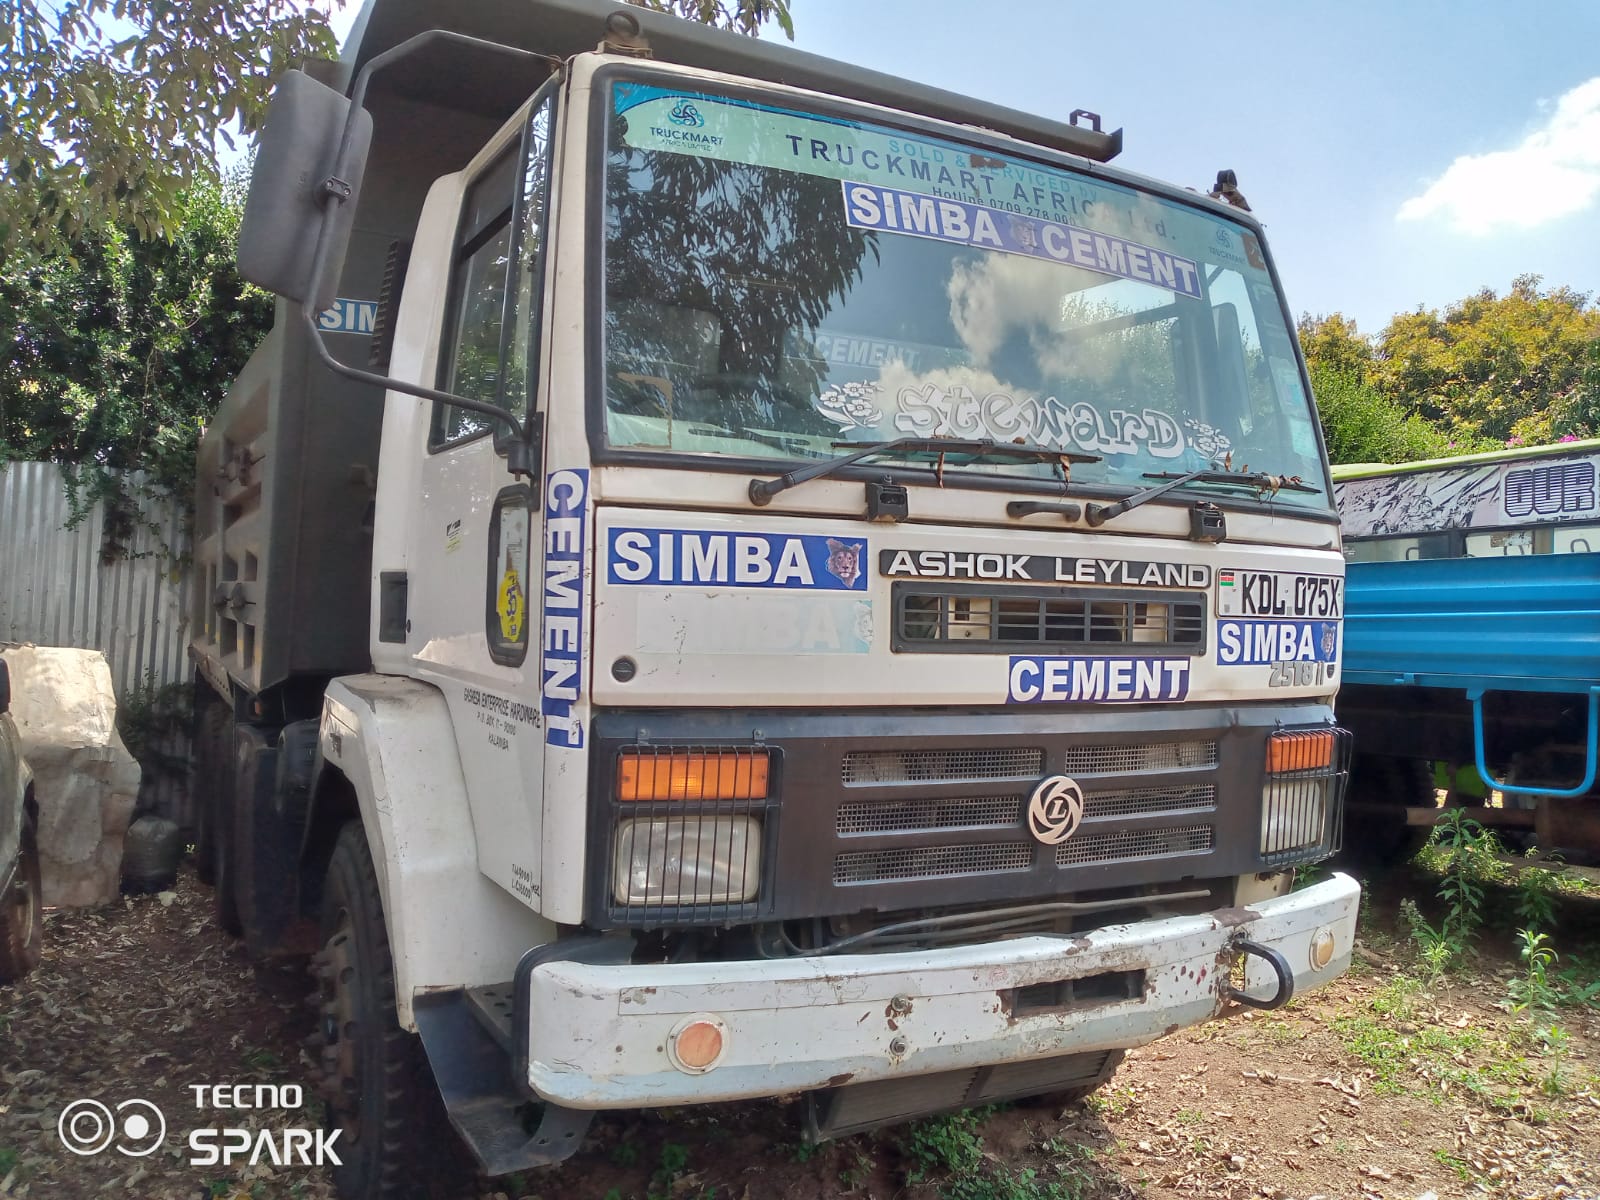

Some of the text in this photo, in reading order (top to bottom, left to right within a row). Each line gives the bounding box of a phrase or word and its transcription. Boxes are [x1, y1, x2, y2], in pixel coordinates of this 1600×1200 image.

[650, 127, 723, 145] TRUCKMART
[889, 139, 944, 163] SOLD
[954, 155, 967, 168] &
[785, 133, 994, 195] TRUCKMART
[932, 186, 985, 206] Hotline
[989, 198, 1022, 215] 0709
[851, 186, 1196, 293] SIMBA CEMENT
[1505, 462, 1595, 517] OUR
[613, 531, 814, 585] SIMBA
[888, 550, 1210, 588] ASHOK LEYLAND
[543, 470, 585, 746] CEMENT
[1241, 573, 1340, 617] KDL 075X
[1220, 622, 1316, 663] SIMBA
[1010, 660, 1189, 703] CEMENT
[1269, 660, 1314, 687] 2518
[481, 692, 509, 717] ENTERPRISE
[510, 702, 541, 729] HARDWARE
